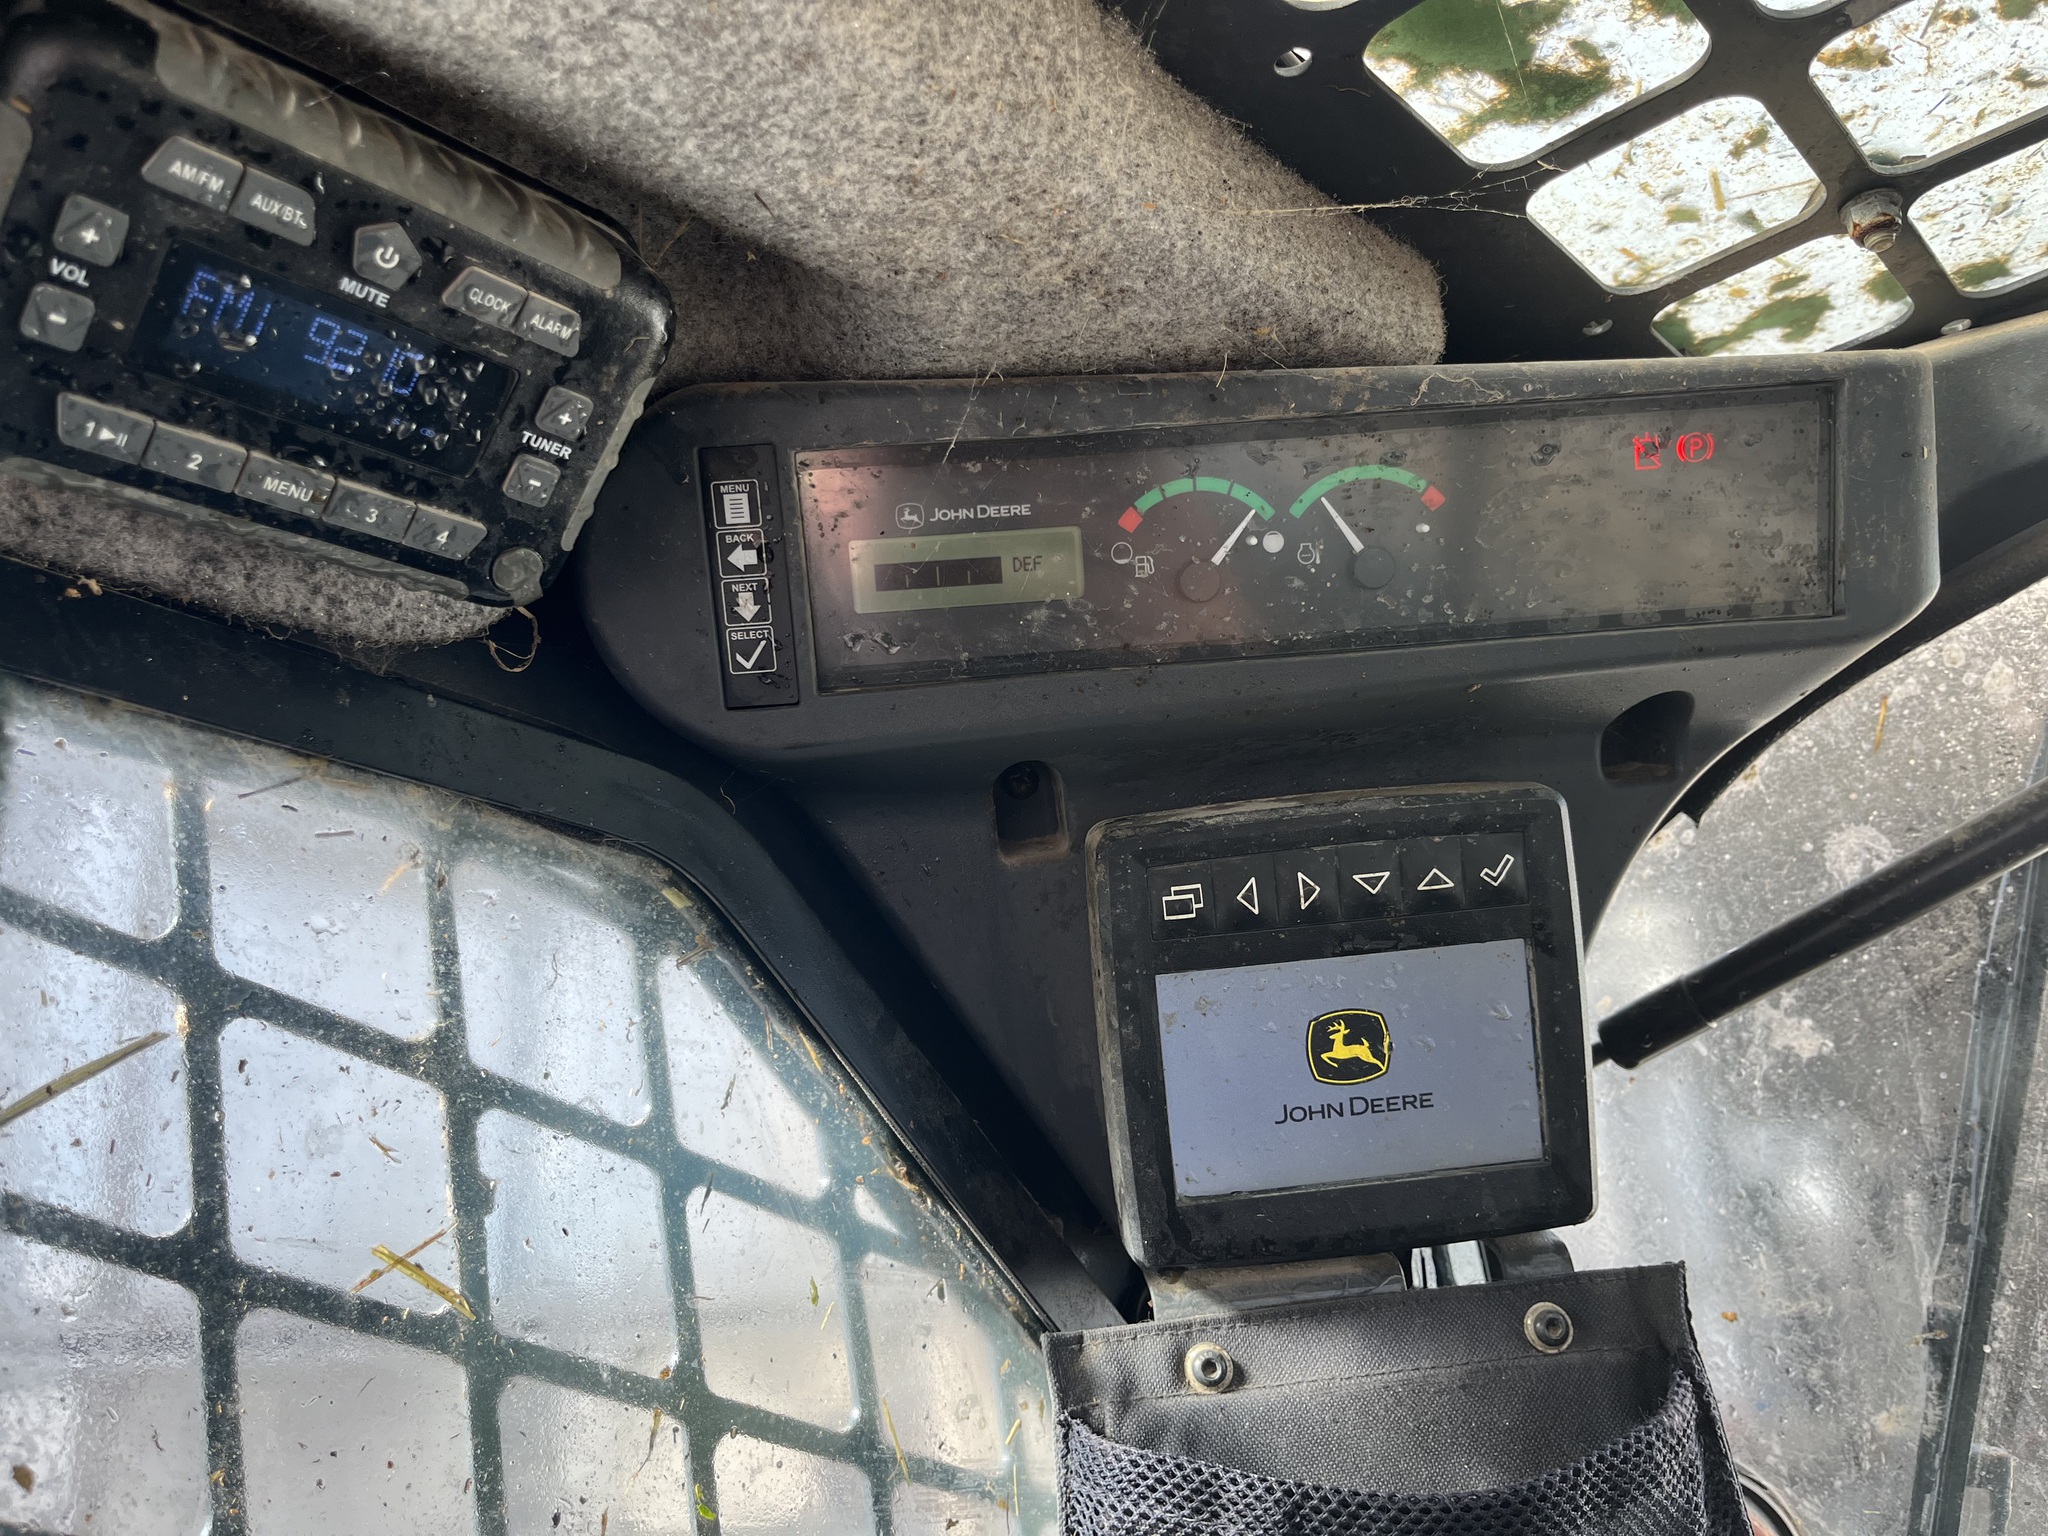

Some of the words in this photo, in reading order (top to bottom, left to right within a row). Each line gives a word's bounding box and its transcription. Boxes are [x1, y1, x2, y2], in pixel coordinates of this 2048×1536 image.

[251, 193, 305, 225] AUX/BT
[50, 258, 89, 287] VOL
[339, 277, 391, 308] MUTE
[469, 287, 512, 313] CLOCK
[530, 314, 573, 341] ALARM
[521, 431, 572, 460] TUNER
[186, 453, 203, 471] 2
[263, 476, 314, 502] MENU
[719, 483, 750, 493] MENU
[365, 508, 379, 523] 3
[929, 507, 974, 522] JOHN
[976, 504, 1032, 519] DEERE
[436, 530, 449, 545] 4
[725, 533, 755, 544] BACK
[1012, 555, 1043, 573] DEF
[731, 582, 758, 592] NEXT
[730, 629, 769, 641] SELECT
[1274, 1101, 1344, 1125] JOHN
[1349, 1092, 1434, 1117] DEERE
